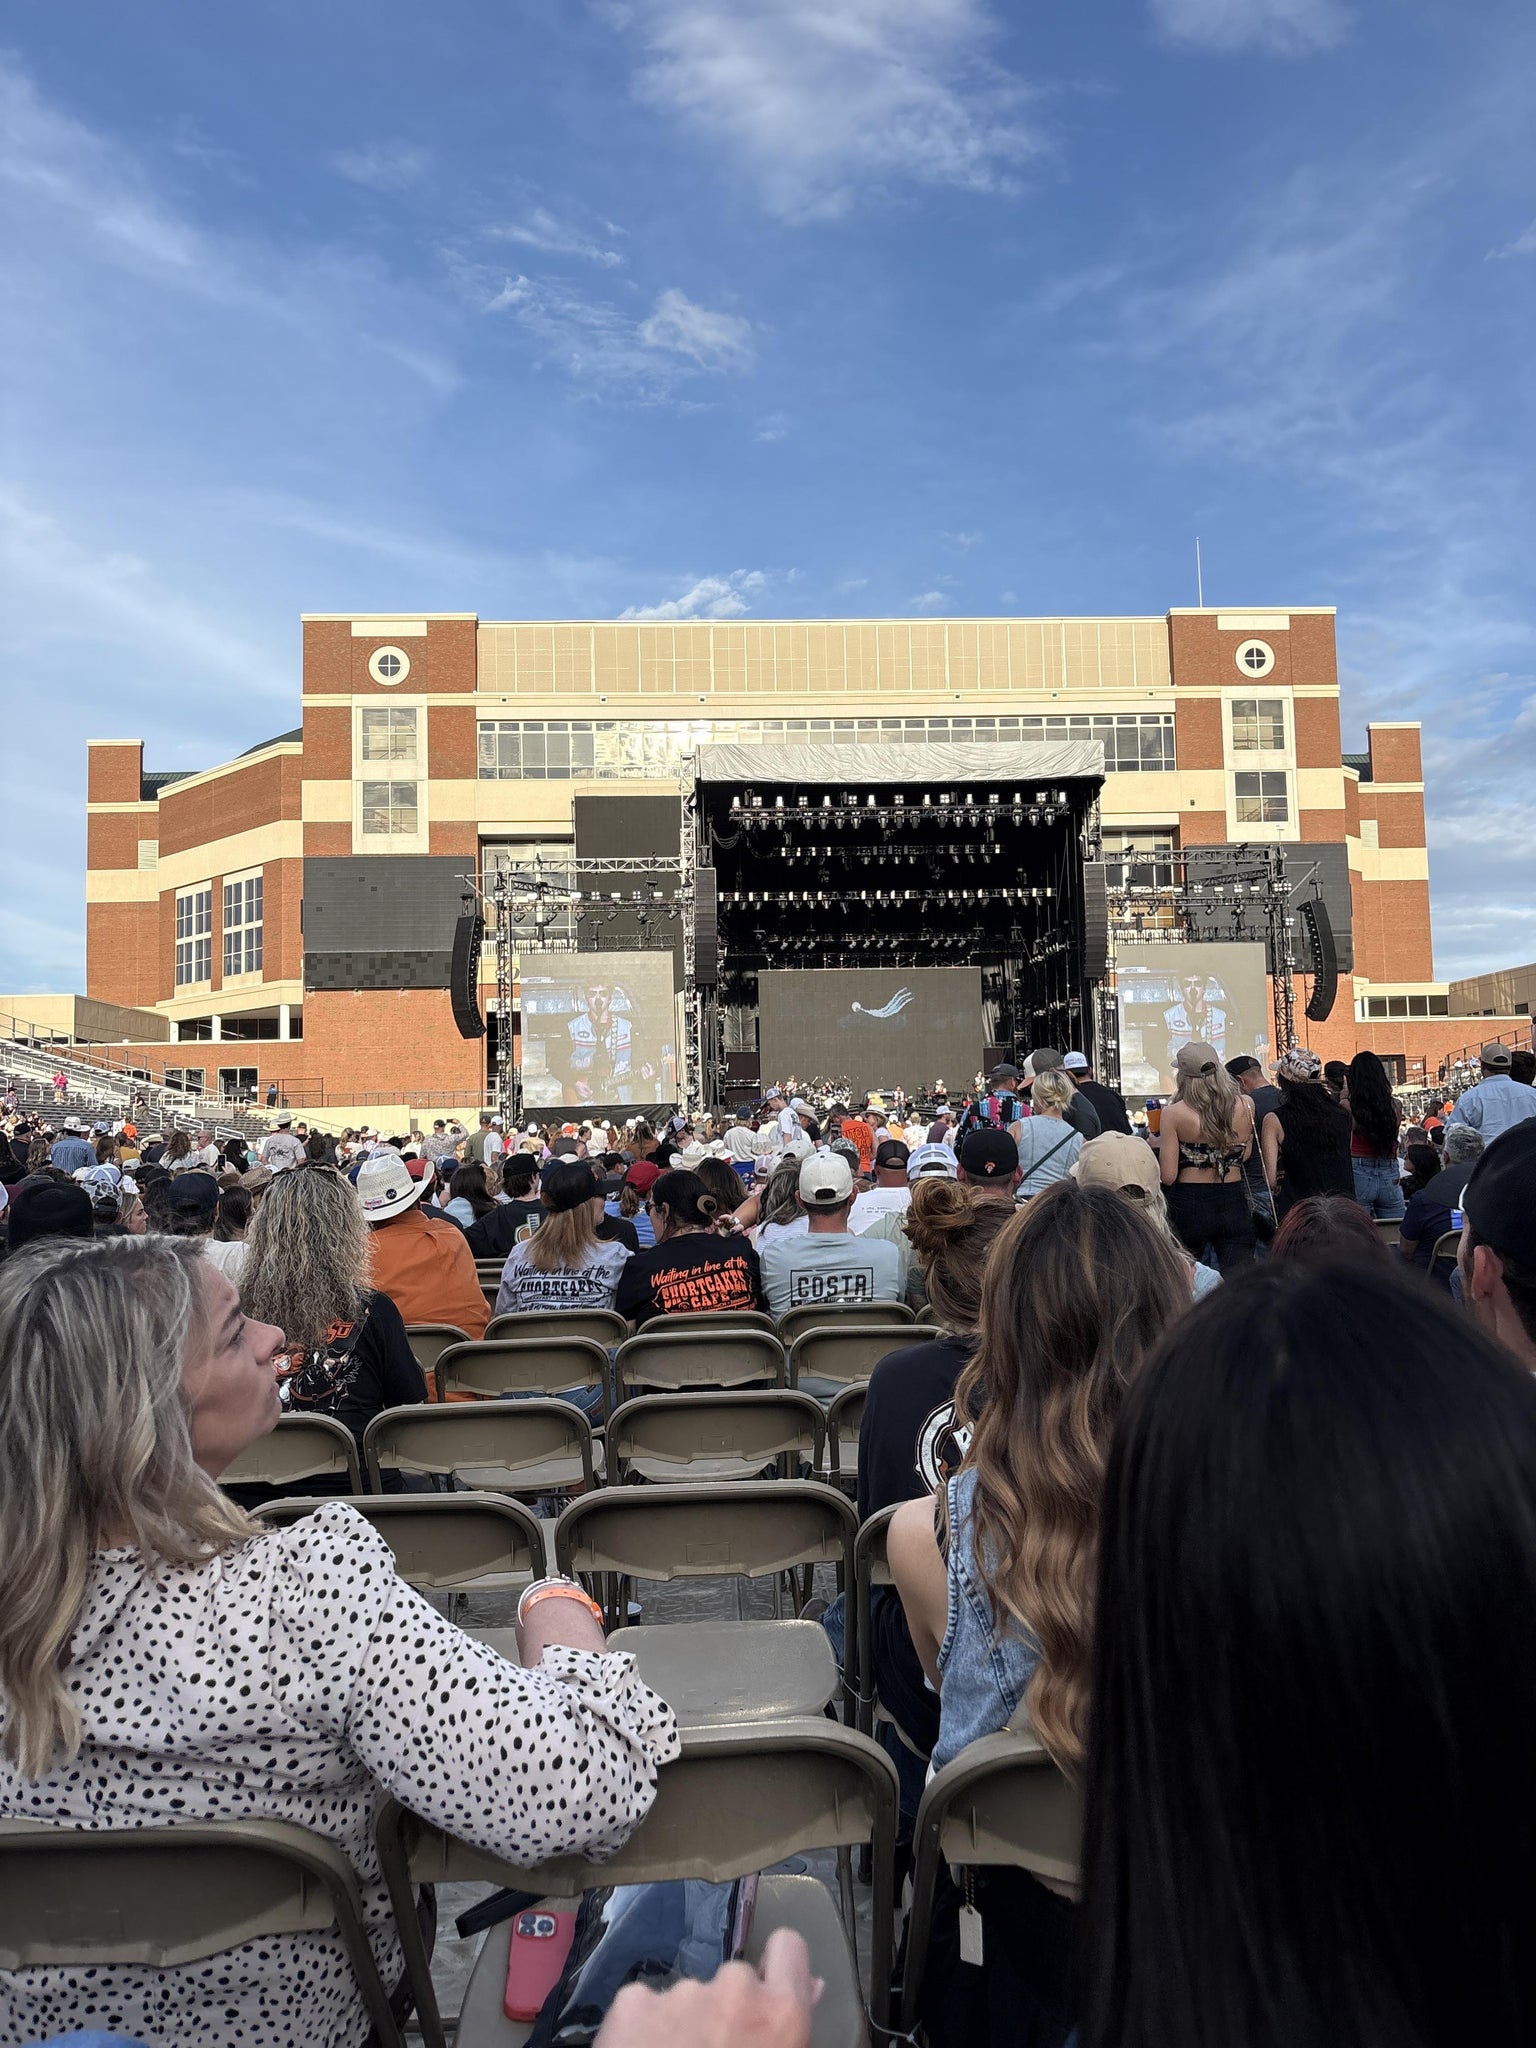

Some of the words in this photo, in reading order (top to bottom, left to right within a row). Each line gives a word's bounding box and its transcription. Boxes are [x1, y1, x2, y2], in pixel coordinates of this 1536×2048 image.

[514, 1262, 549, 1279] Waiting
[582, 1265, 594, 1279] at
[595, 1264, 610, 1279] the
[650, 1268, 689, 1288] Waiting
[692, 1265, 701, 1275] in
[704, 1260, 721, 1272] line
[724, 1256, 735, 1269] at
[735, 1255, 749, 1269] the
[661, 1270, 747, 1308] SHORTCAKES
[797, 1274, 867, 1297] COSTA
[690, 1290, 730, 1308] CAFE
